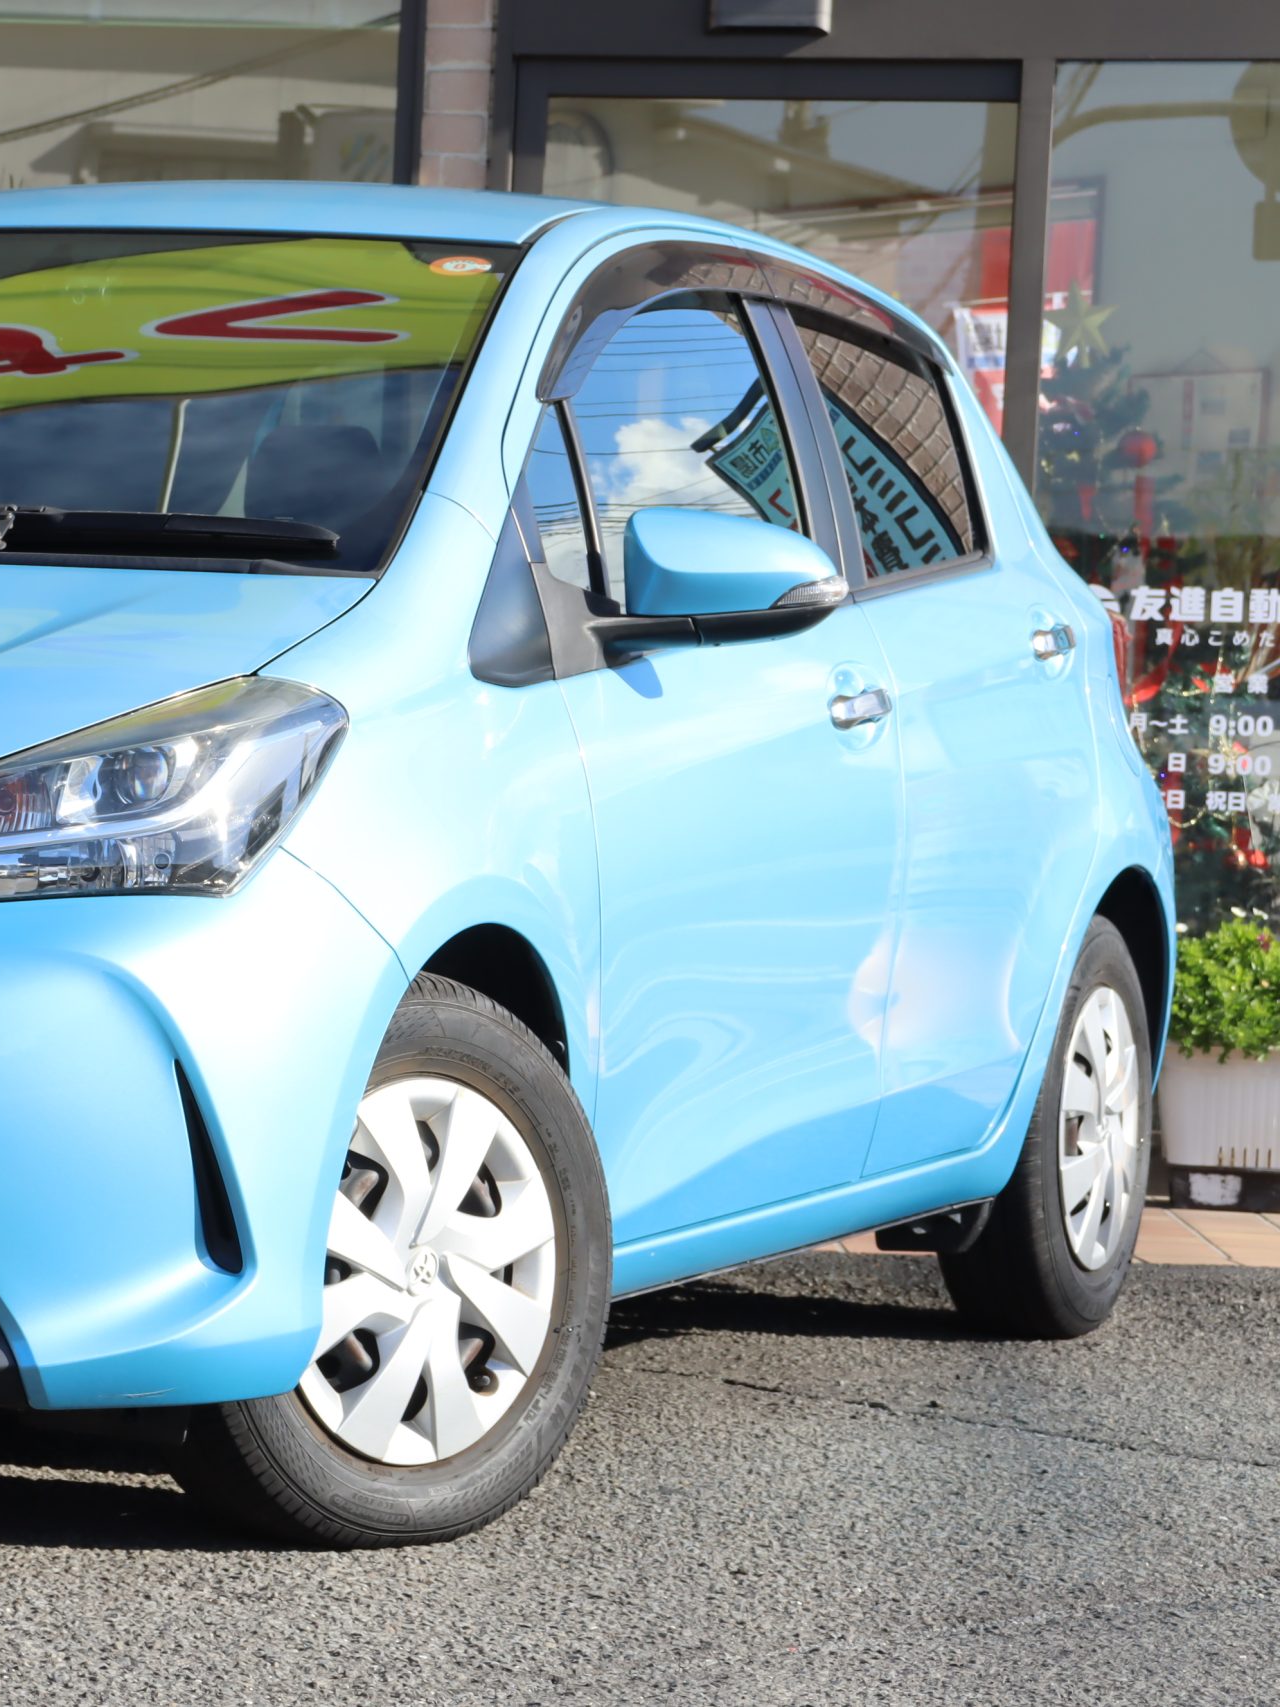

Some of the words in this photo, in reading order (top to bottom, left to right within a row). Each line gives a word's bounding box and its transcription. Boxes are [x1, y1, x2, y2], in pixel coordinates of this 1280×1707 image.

[1209, 715, 1274, 737] 9:00
[1168, 753, 1187, 773] 日
[1207, 755, 1272, 777] 9:00
[1161, 789, 1186, 810] 日
